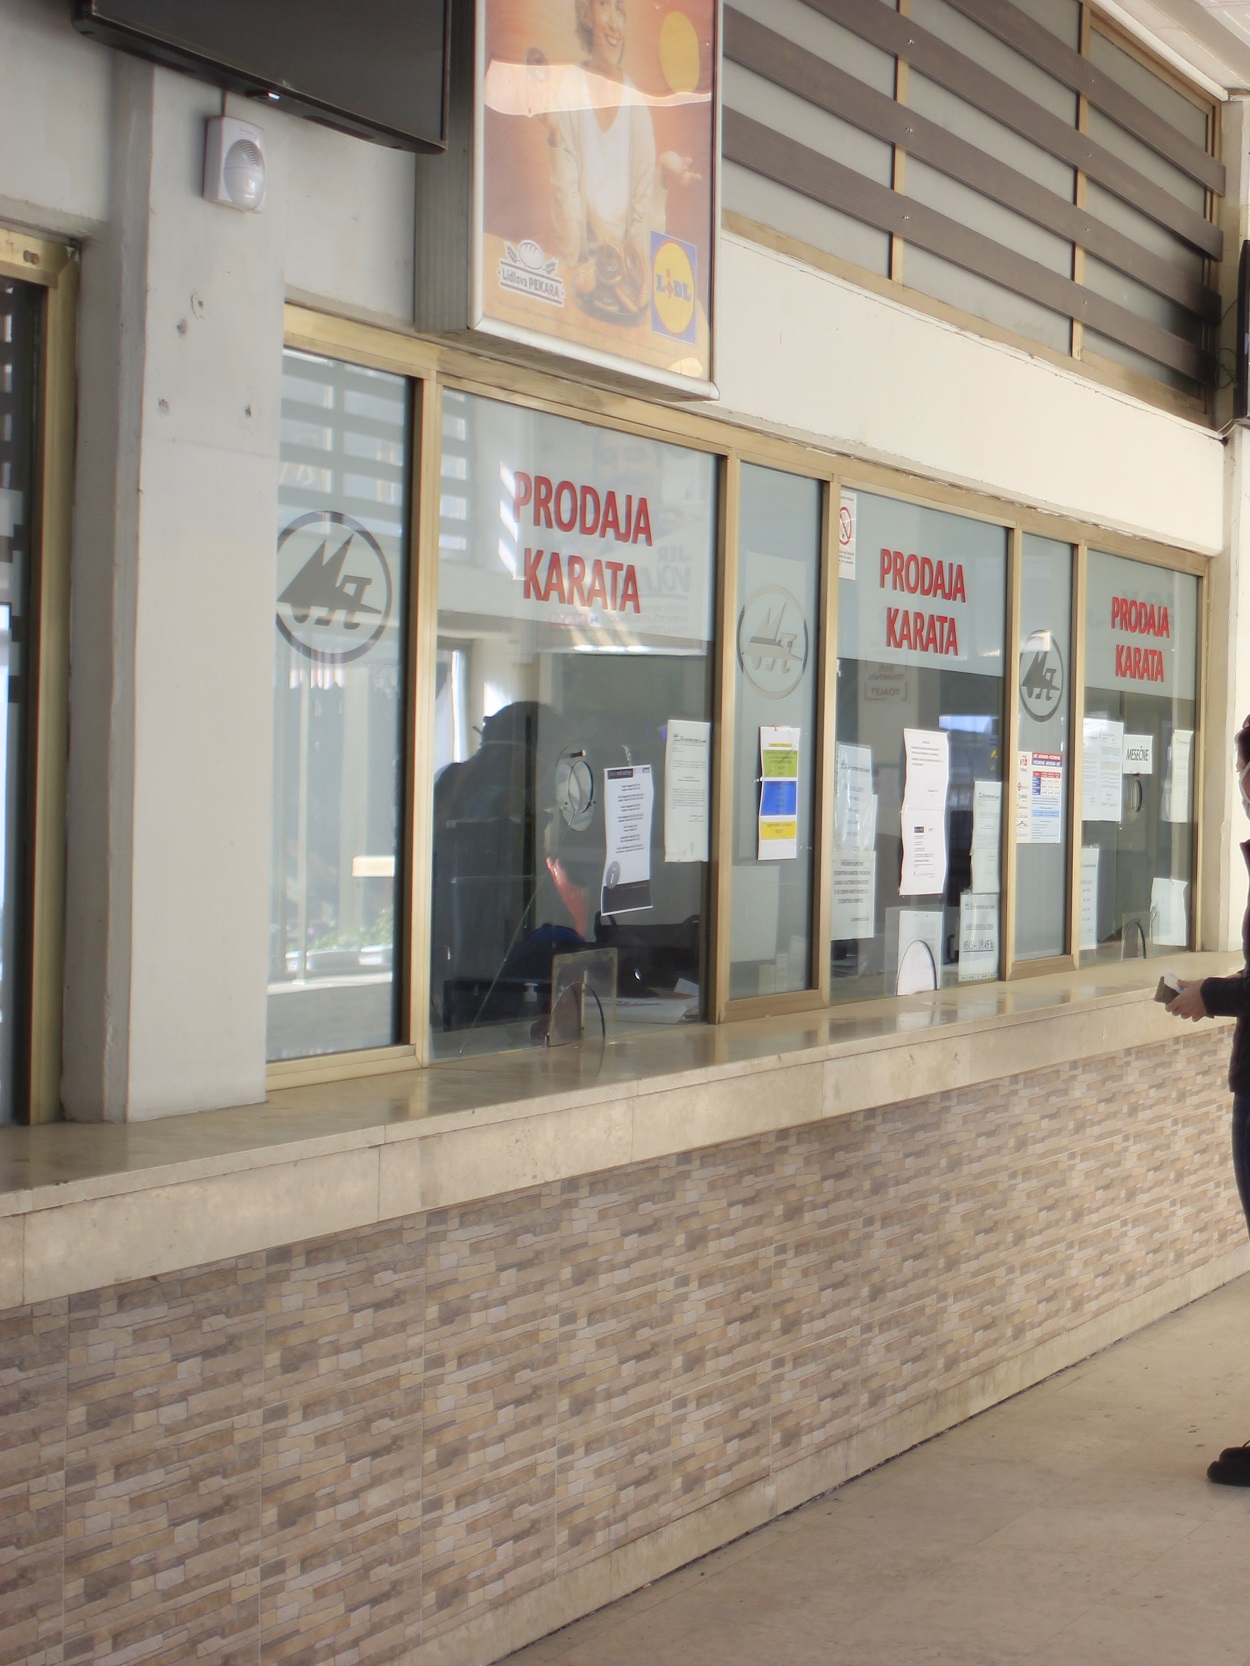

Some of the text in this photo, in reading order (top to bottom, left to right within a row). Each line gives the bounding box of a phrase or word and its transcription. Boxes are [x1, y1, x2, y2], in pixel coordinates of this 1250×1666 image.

[502, 268, 560, 298] Lidlova PEKARA
[513, 471, 653, 547] PRODAJA
[523, 547, 641, 614] KARATA
[880, 548, 966, 603] PRODAJA
[886, 607, 958, 656] KARATA
[1111, 596, 1170, 639] PRODAJA
[1115, 644, 1165, 683] KARATA
